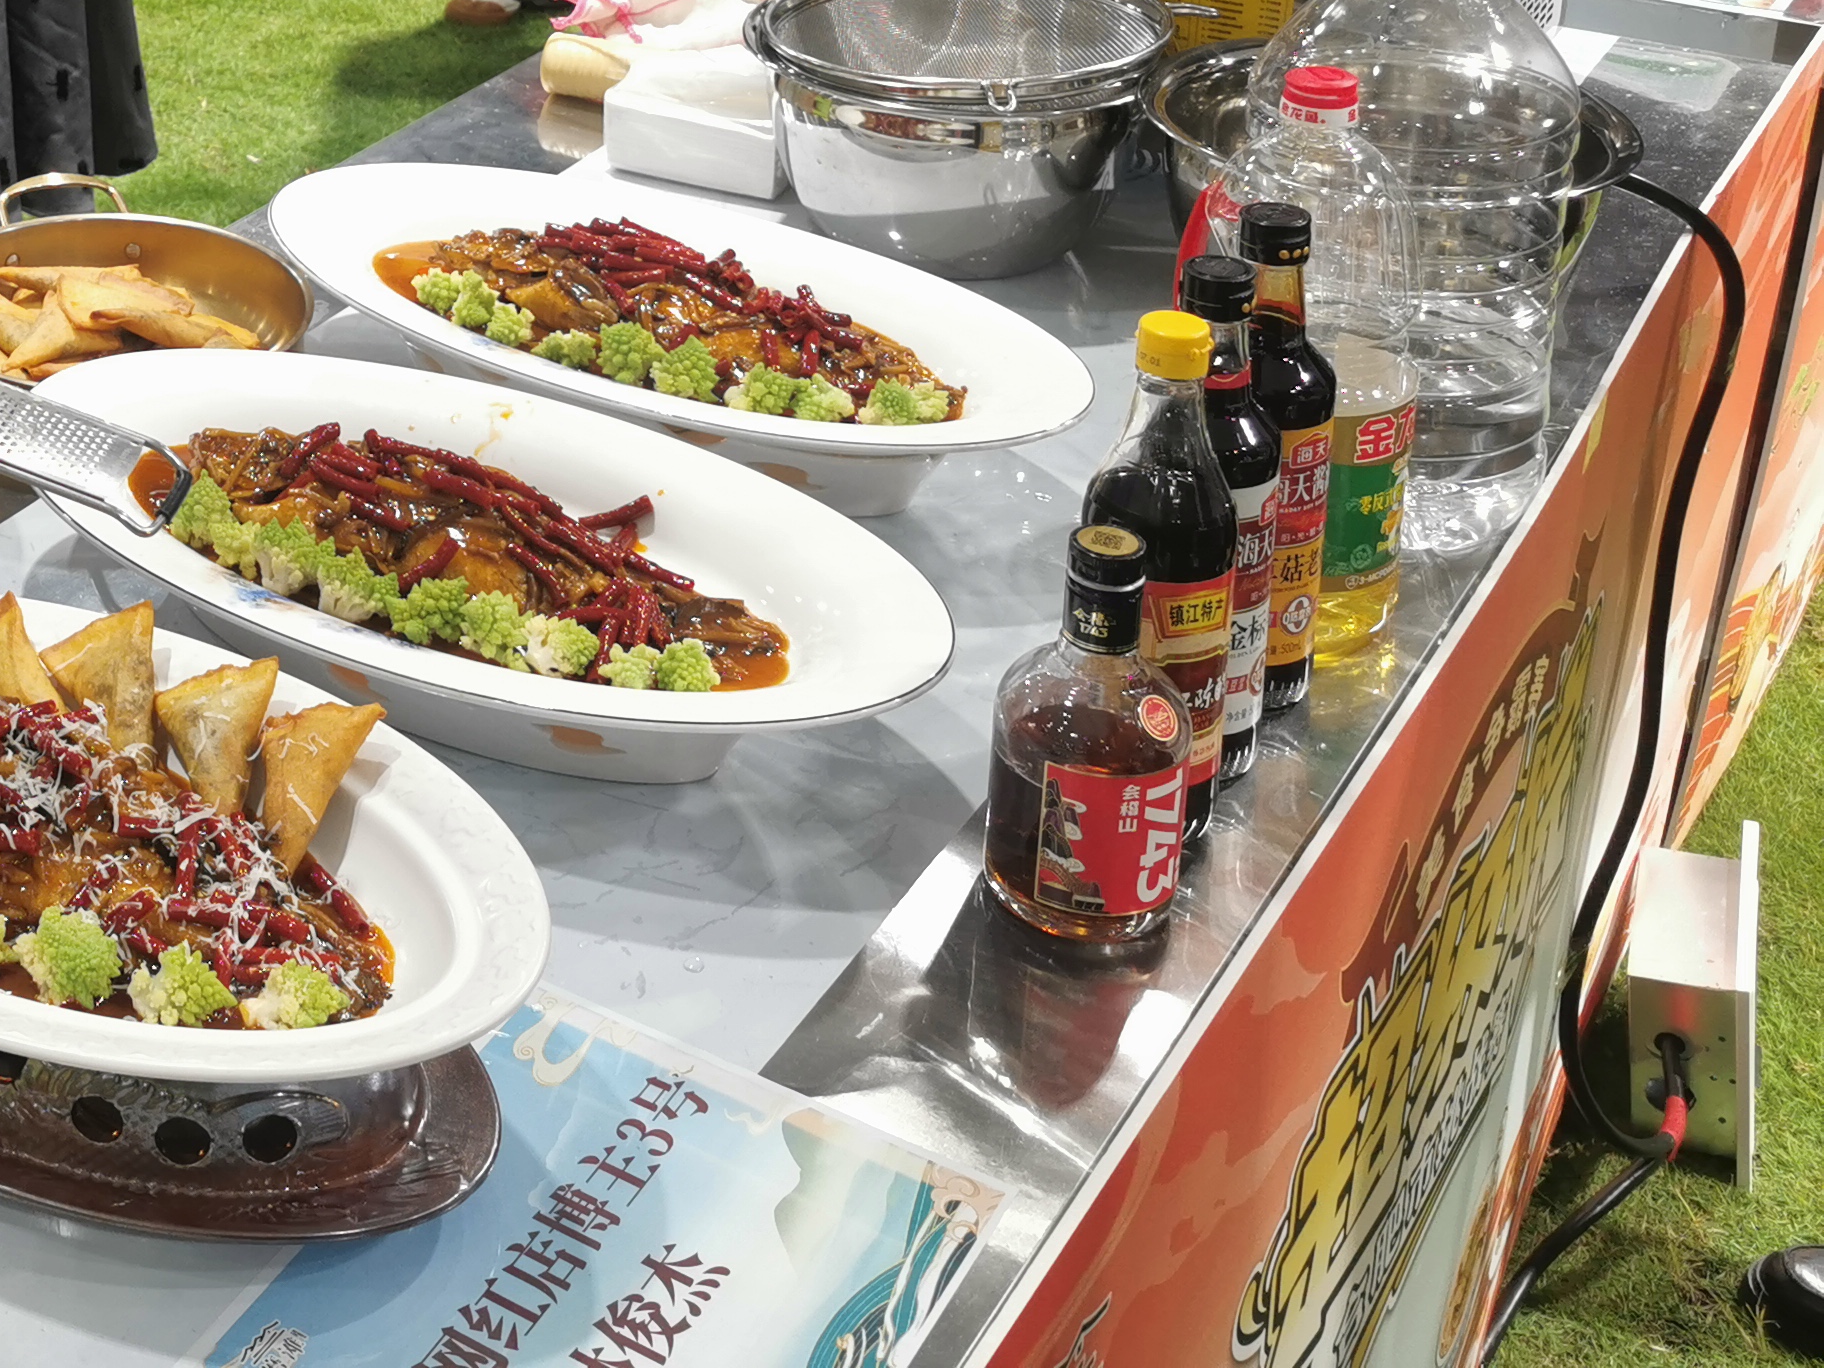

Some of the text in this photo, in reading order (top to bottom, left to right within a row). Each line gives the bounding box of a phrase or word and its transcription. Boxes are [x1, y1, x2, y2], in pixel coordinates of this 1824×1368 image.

[1169, 598, 1225, 627] 镇江特产
[1118, 783, 1142, 834] 会稽山
[1136, 766, 1184, 904] 1743
[410, 1075, 710, 1368] 网红店博主3号
